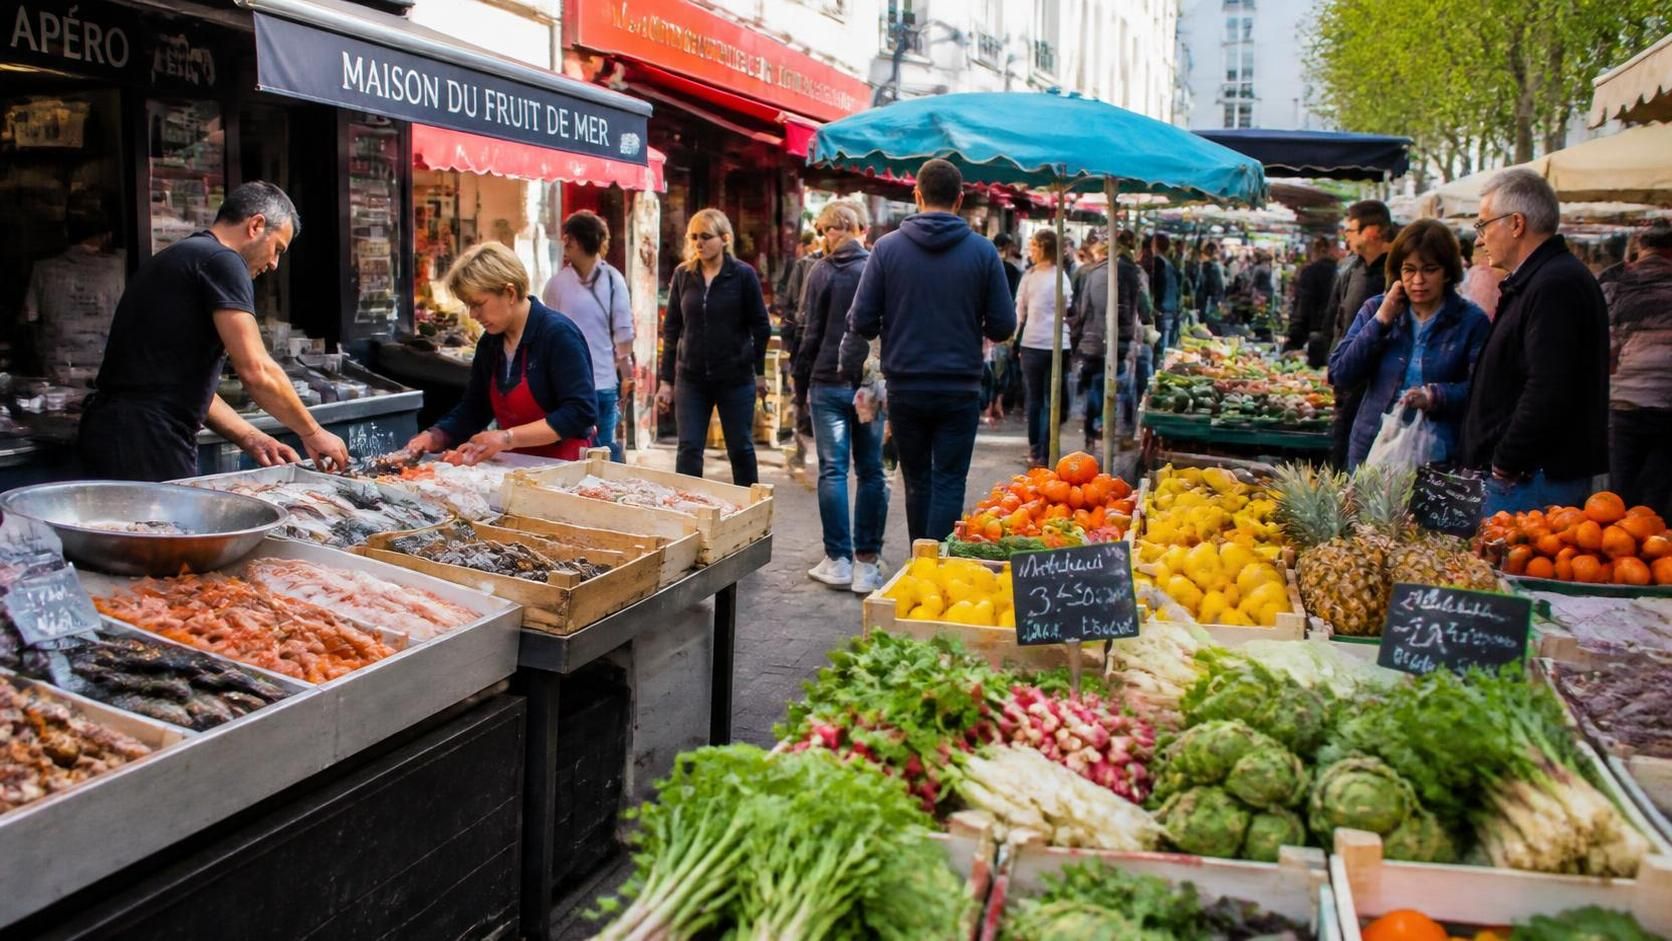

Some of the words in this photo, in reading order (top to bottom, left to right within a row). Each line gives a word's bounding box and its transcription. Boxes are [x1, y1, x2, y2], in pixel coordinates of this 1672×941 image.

[10, 4, 129, 68] APÉRO
[342, 51, 439, 109] MAISON
[447, 79, 477, 117] DU
[484, 89, 541, 131] FRUIT
[547, 105, 569, 138] DE
[574, 111, 610, 146] MER
